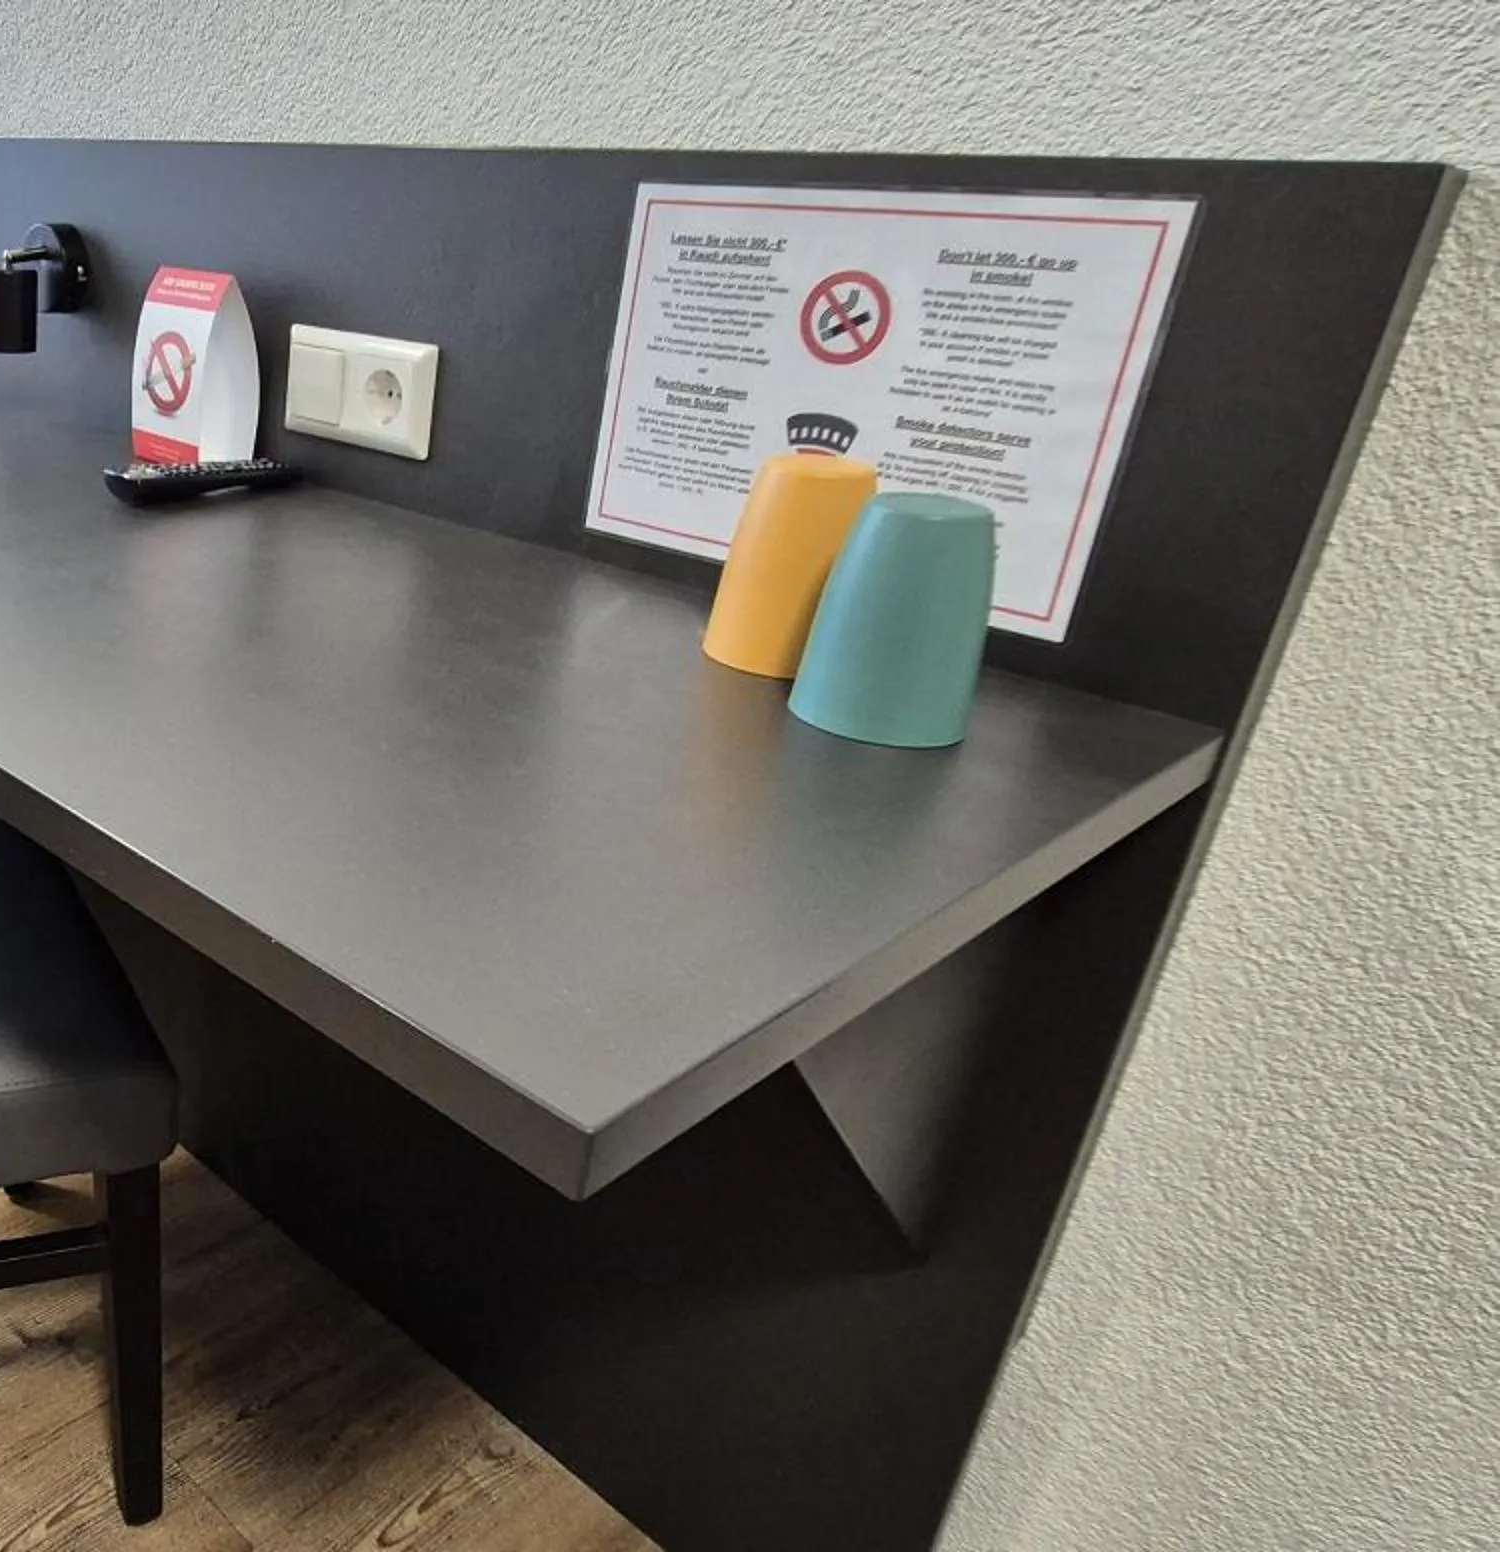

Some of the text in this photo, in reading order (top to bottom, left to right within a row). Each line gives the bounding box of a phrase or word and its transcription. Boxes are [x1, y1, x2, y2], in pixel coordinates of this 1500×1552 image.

[705, 235, 720, 247] Sie
[938, 249, 972, 264] Don't
[973, 251, 992, 265] let
[985, 272, 1034, 287] smoke!
[895, 415, 935, 433] Smoke
